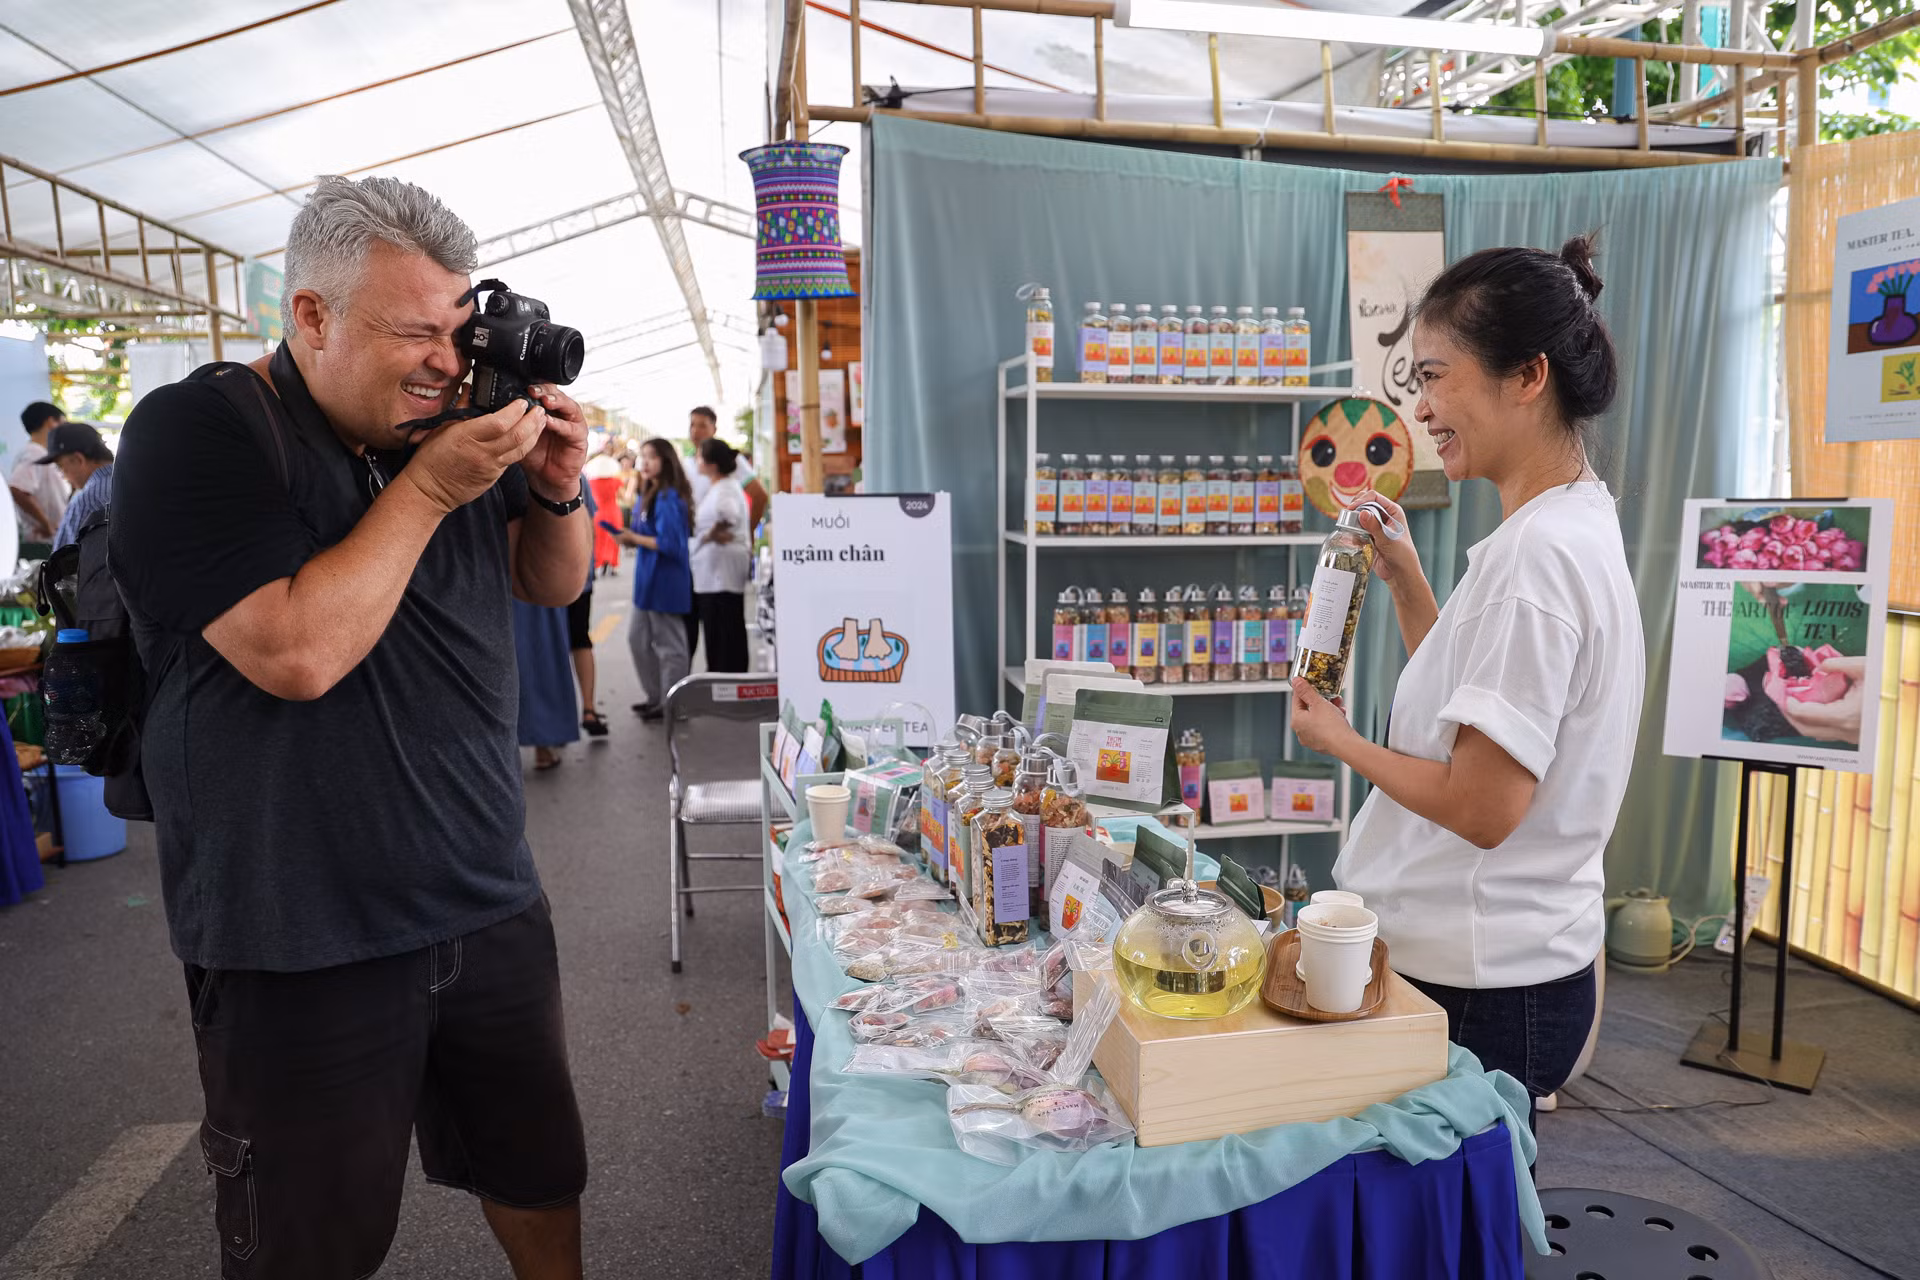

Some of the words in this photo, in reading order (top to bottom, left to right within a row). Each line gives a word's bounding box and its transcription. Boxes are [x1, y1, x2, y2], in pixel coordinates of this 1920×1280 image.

[1848, 233, 1888, 250] MASTER
[519, 333, 529, 361] Canon
[905, 500, 928, 510] 2024
[782, 544, 833, 564] ngâm
[839, 544, 885, 562] chân
[1680, 580, 1713, 590] MASTER
[1715, 581, 1731, 590] TEA
[1702, 600, 1732, 617] THE
[1802, 600, 1864, 619] LOTUS
[1804, 623, 1837, 641] TEA
[904, 721, 928, 733] TEA
